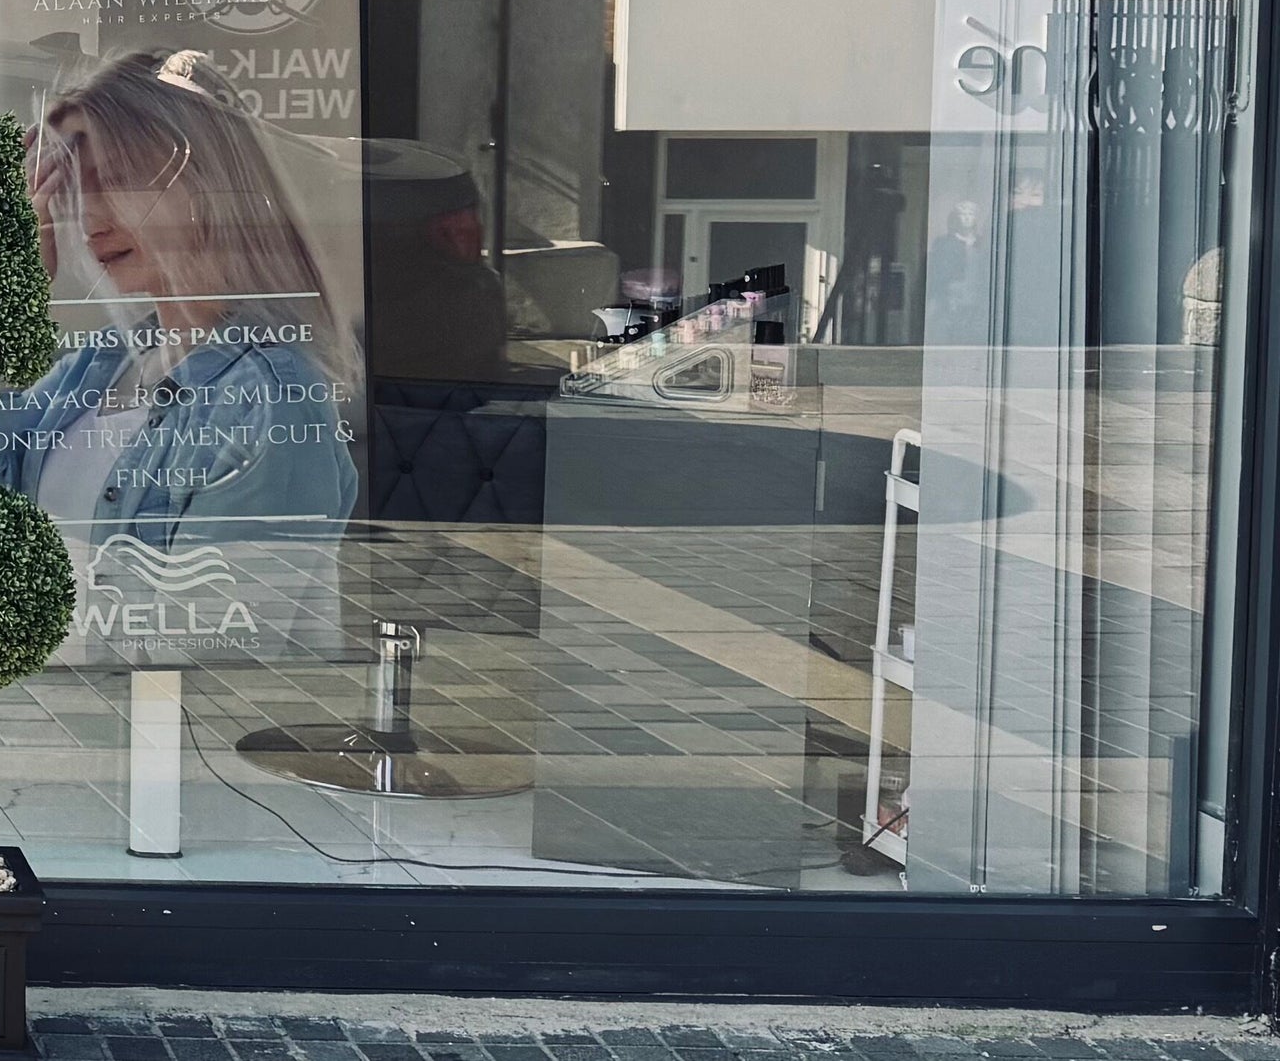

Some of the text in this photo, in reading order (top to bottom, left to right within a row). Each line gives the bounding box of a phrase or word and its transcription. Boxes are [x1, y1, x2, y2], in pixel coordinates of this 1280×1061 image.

[82, 11, 222, 25] HAIR EXPERTS
[126, 327, 183, 348] KISS
[190, 323, 314, 346] PACKAGE
[134, 386, 217, 407] ROOT
[223, 382, 353, 406] SMUDGE,
[79, 425, 260, 451] TREATMENT,
[267, 423, 327, 444] CUT
[333, 419, 356, 444] &
[115, 468, 209, 489] FINISH
[71, 601, 259, 637] WELLA
[121, 637, 260, 651] PROFESSIONALS
